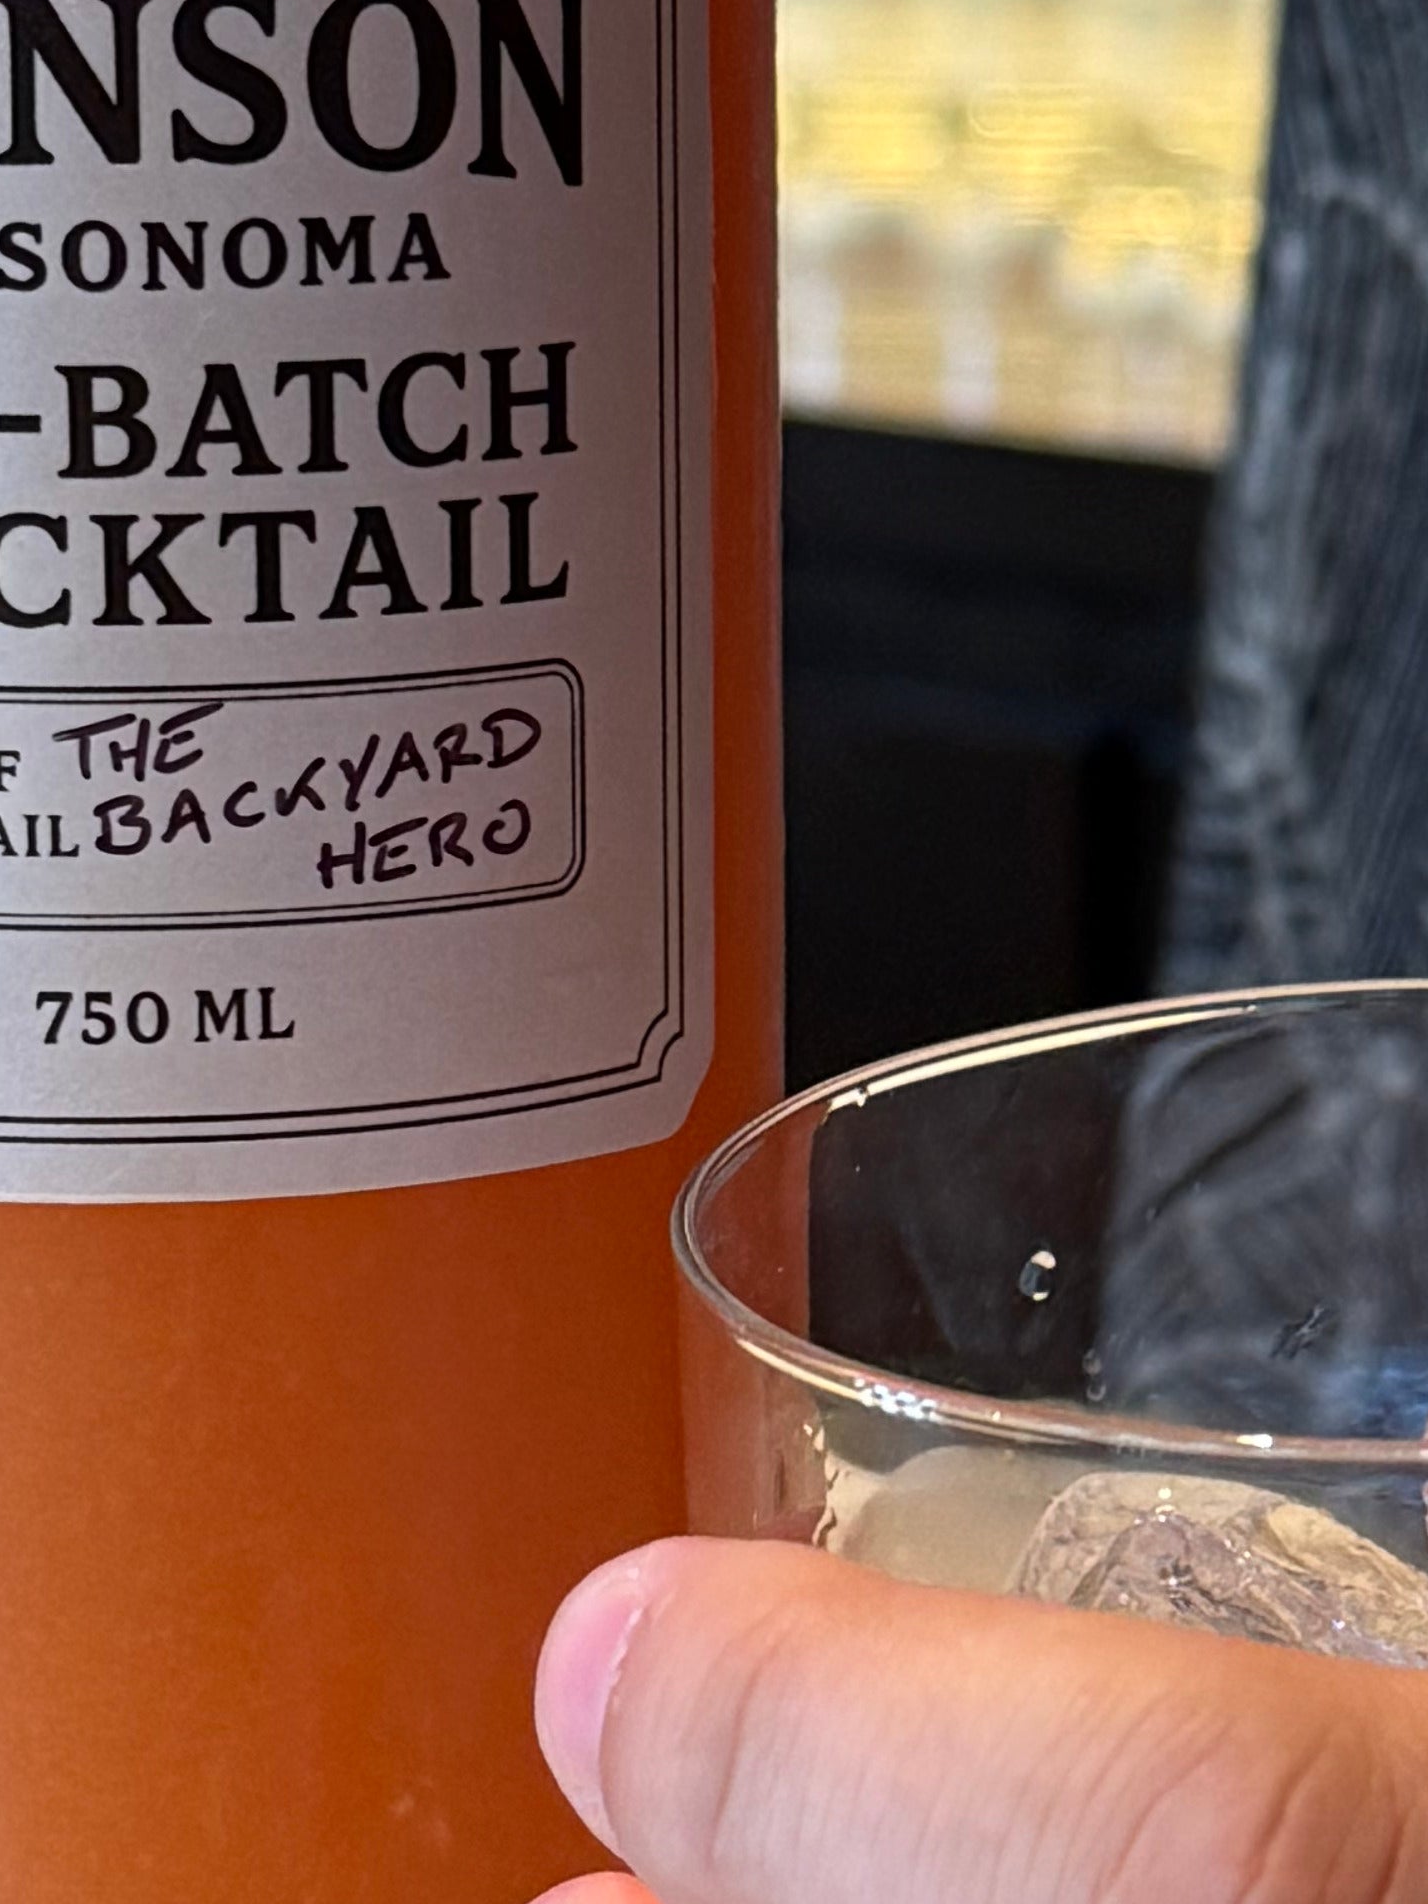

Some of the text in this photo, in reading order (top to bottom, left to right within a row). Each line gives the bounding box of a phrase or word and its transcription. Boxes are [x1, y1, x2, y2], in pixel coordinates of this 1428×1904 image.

[52, 702, 224, 782] THE
[94, 707, 542, 856] BACKYARD
[316, 799, 532, 889] HERO
[35, 986, 296, 1046] 750 ML
